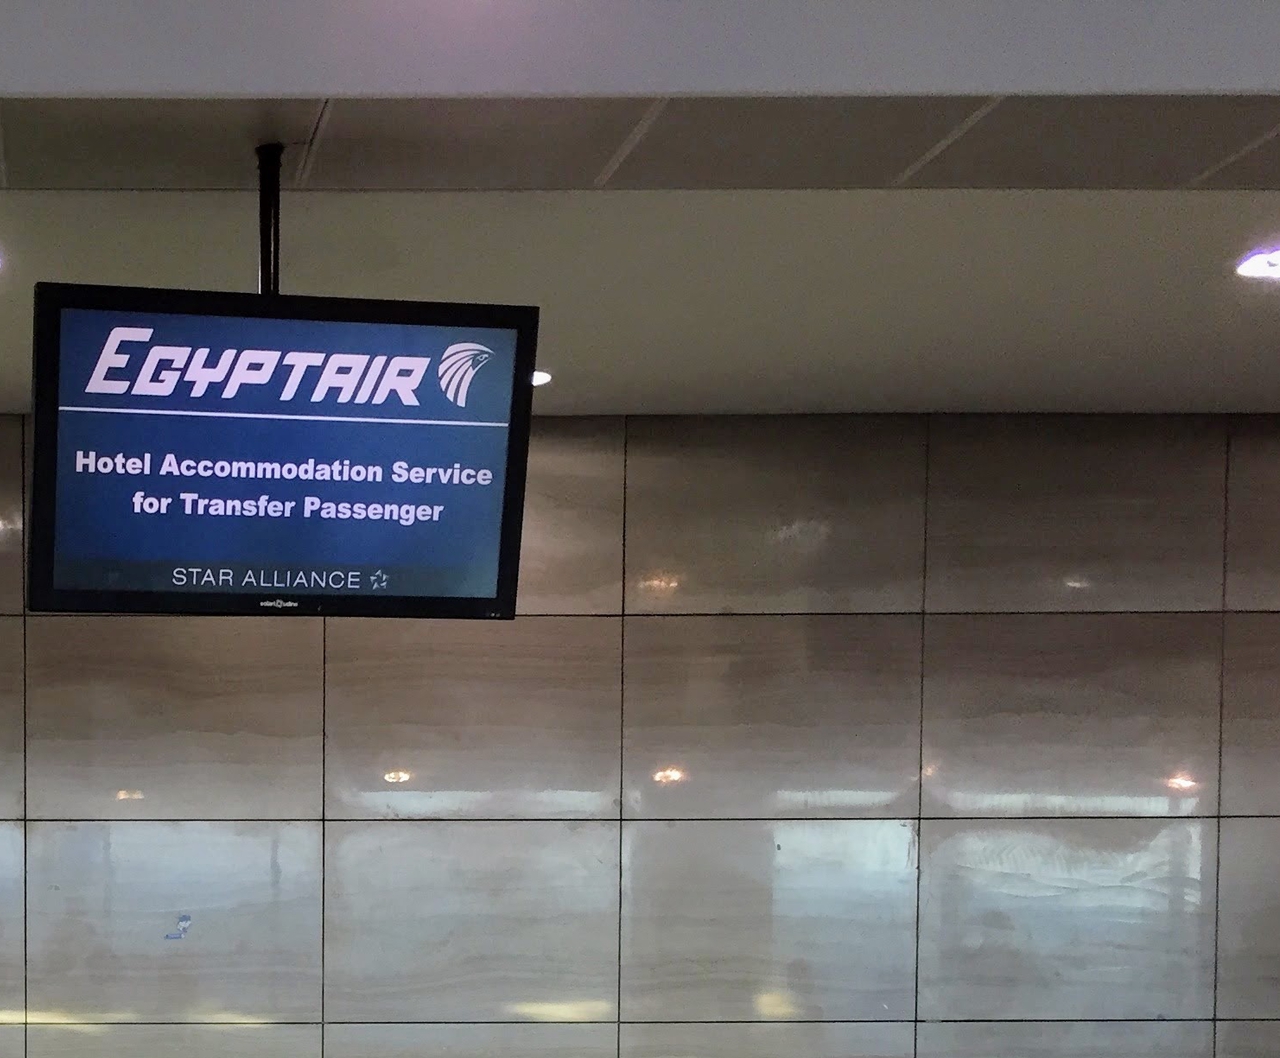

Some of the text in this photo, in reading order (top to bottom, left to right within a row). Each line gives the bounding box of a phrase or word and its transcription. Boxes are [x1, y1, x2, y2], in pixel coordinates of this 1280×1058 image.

[84, 326, 431, 407] EGYPTAIR
[75, 450, 493, 485] Hotel Accommodation Service
[132, 491, 445, 526] for Transfer Passenger
[172, 567, 361, 589] STAR ALLIANCE
